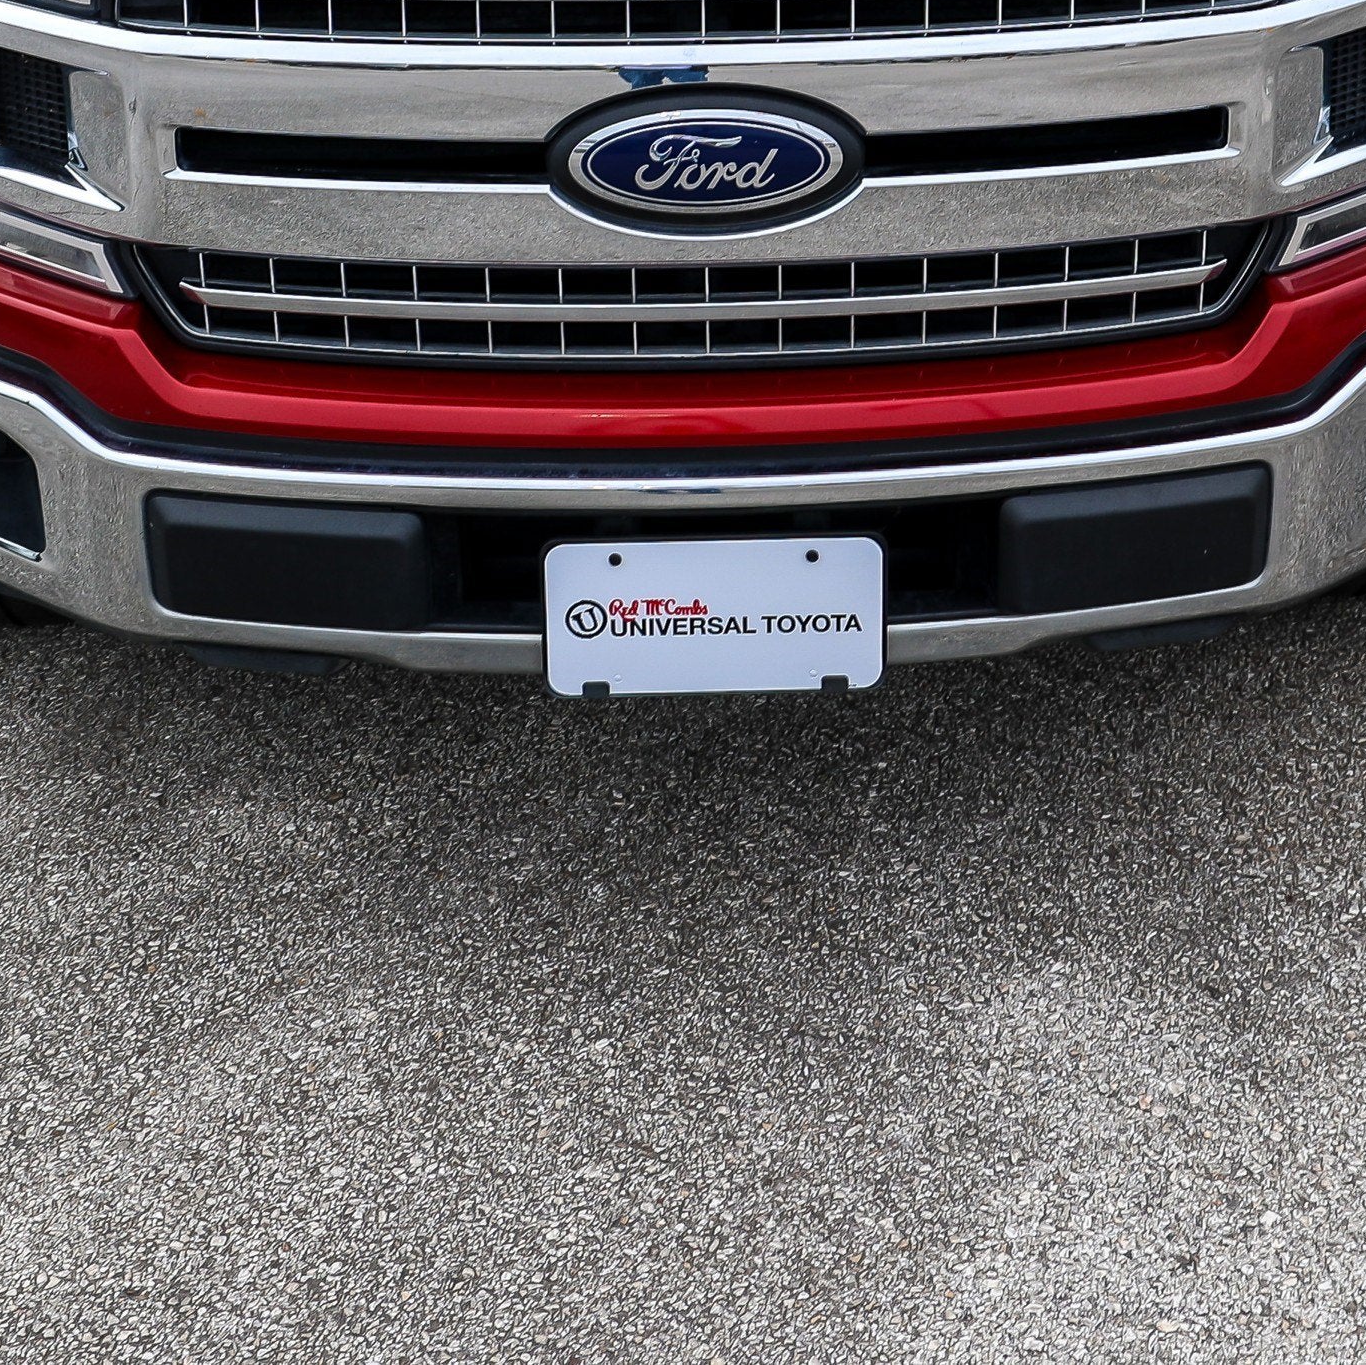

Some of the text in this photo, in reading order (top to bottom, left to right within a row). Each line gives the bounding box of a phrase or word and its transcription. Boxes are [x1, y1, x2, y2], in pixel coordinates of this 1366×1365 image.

[635, 134, 778, 190] Ford
[609, 599, 708, 622] Red McCombs
[610, 613, 863, 637] UNIVERSAL TOYOTA
